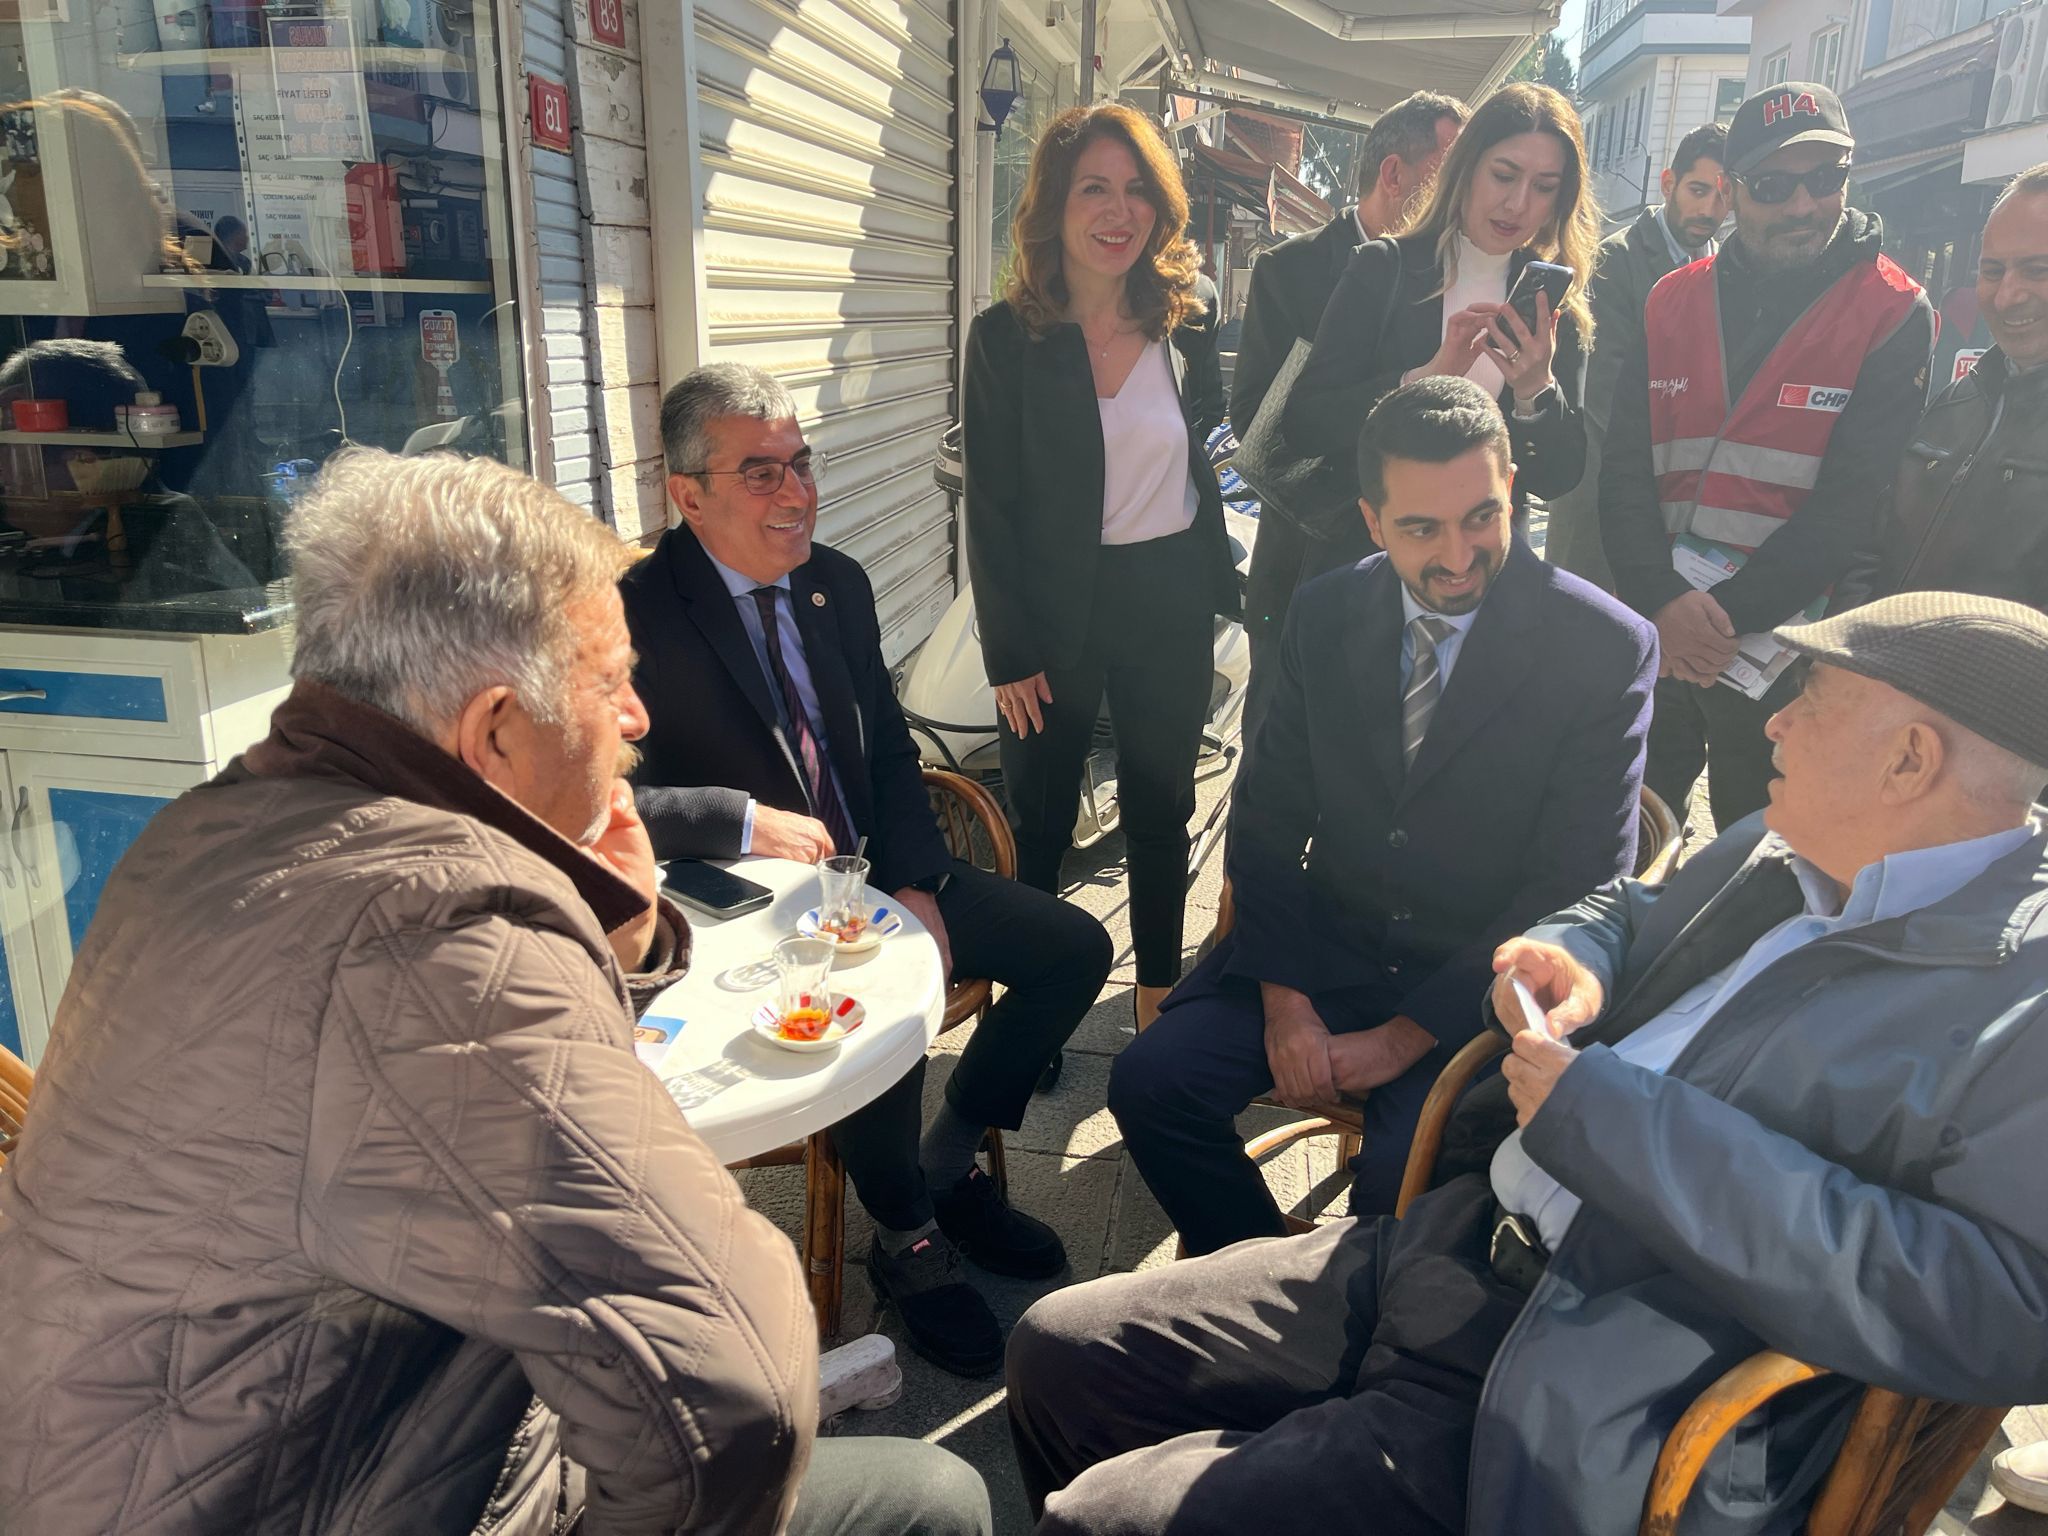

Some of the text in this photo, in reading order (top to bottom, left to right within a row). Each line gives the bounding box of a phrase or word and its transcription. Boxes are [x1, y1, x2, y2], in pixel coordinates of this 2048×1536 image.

[600, 0, 618, 33] 83
[277, 87, 331, 99] FİYAT LİSTESİ
[1764, 92, 1819, 126] H4
[545, 94, 562, 133] 81
[1811, 391, 1848, 408] CHP
